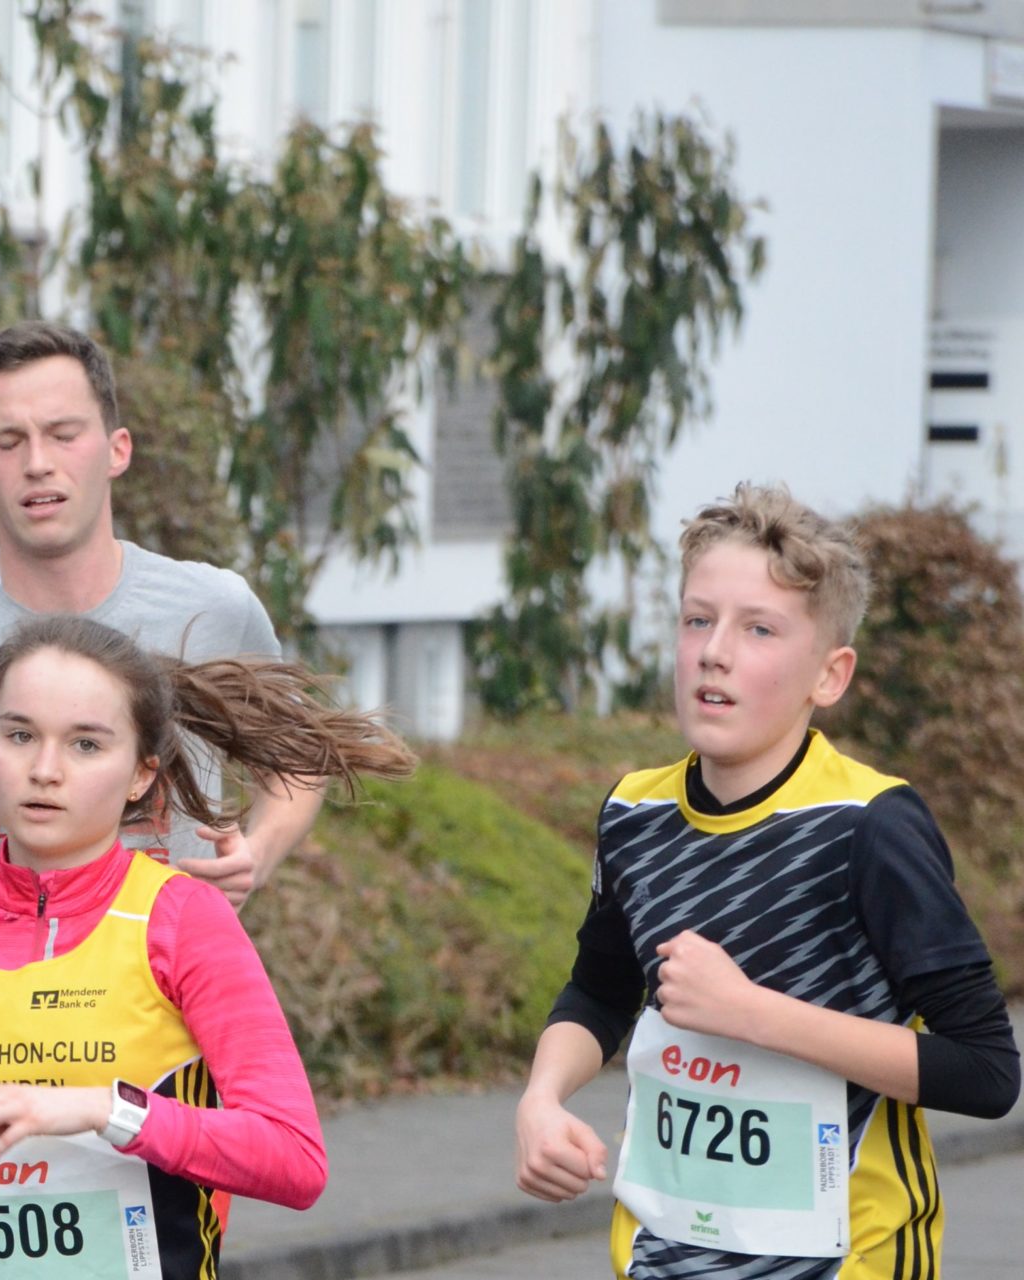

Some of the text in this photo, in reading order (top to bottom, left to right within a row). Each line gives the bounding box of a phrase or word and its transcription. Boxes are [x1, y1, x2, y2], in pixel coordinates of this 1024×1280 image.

[59, 999, 97, 1009] Bank eG
[60, 987, 108, 997] Mendener
[657, 1091, 771, 1166] 6726
[690, 1224, 720, 1236] erima
[129, 1228, 140, 1272] PADERBORN
[137, 1228, 148, 1267] LIPPSTADT
